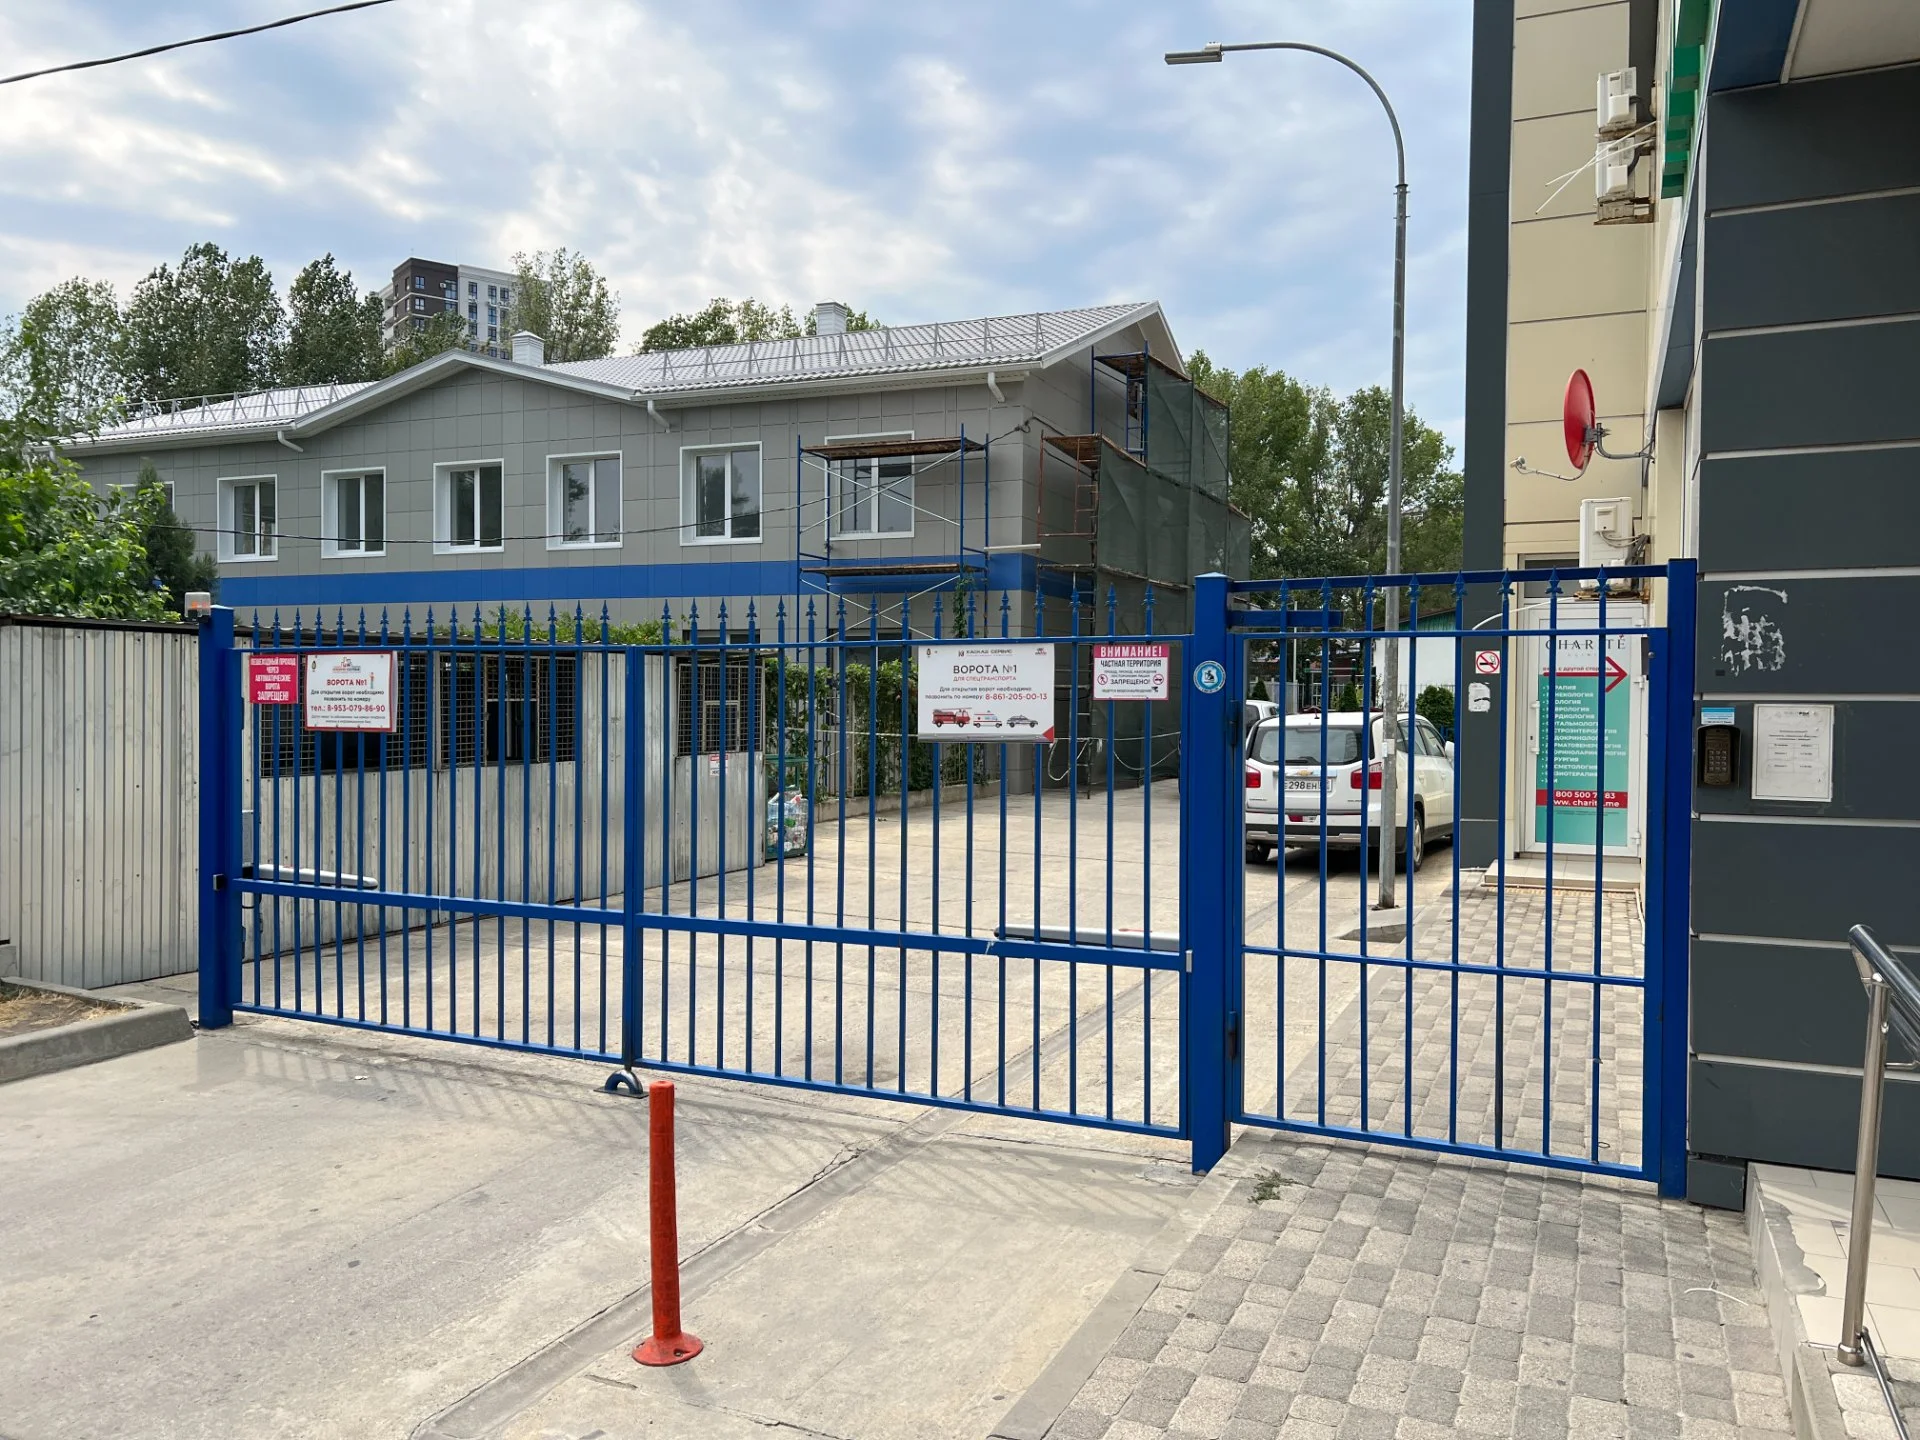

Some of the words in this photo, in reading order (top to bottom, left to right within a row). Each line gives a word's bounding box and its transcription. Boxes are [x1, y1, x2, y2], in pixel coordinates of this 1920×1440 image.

[1545, 636, 1626, 649] CHARTÉ
[1100, 646, 1162, 657] ВНИМАНИЕ!
[279, 658, 296, 666] ПРОХОД
[953, 665, 998, 674] ВОРОТА
[1002, 665, 1017, 673] №1
[255, 674, 291, 682] АВТОМАТИЧЕСКИЕ
